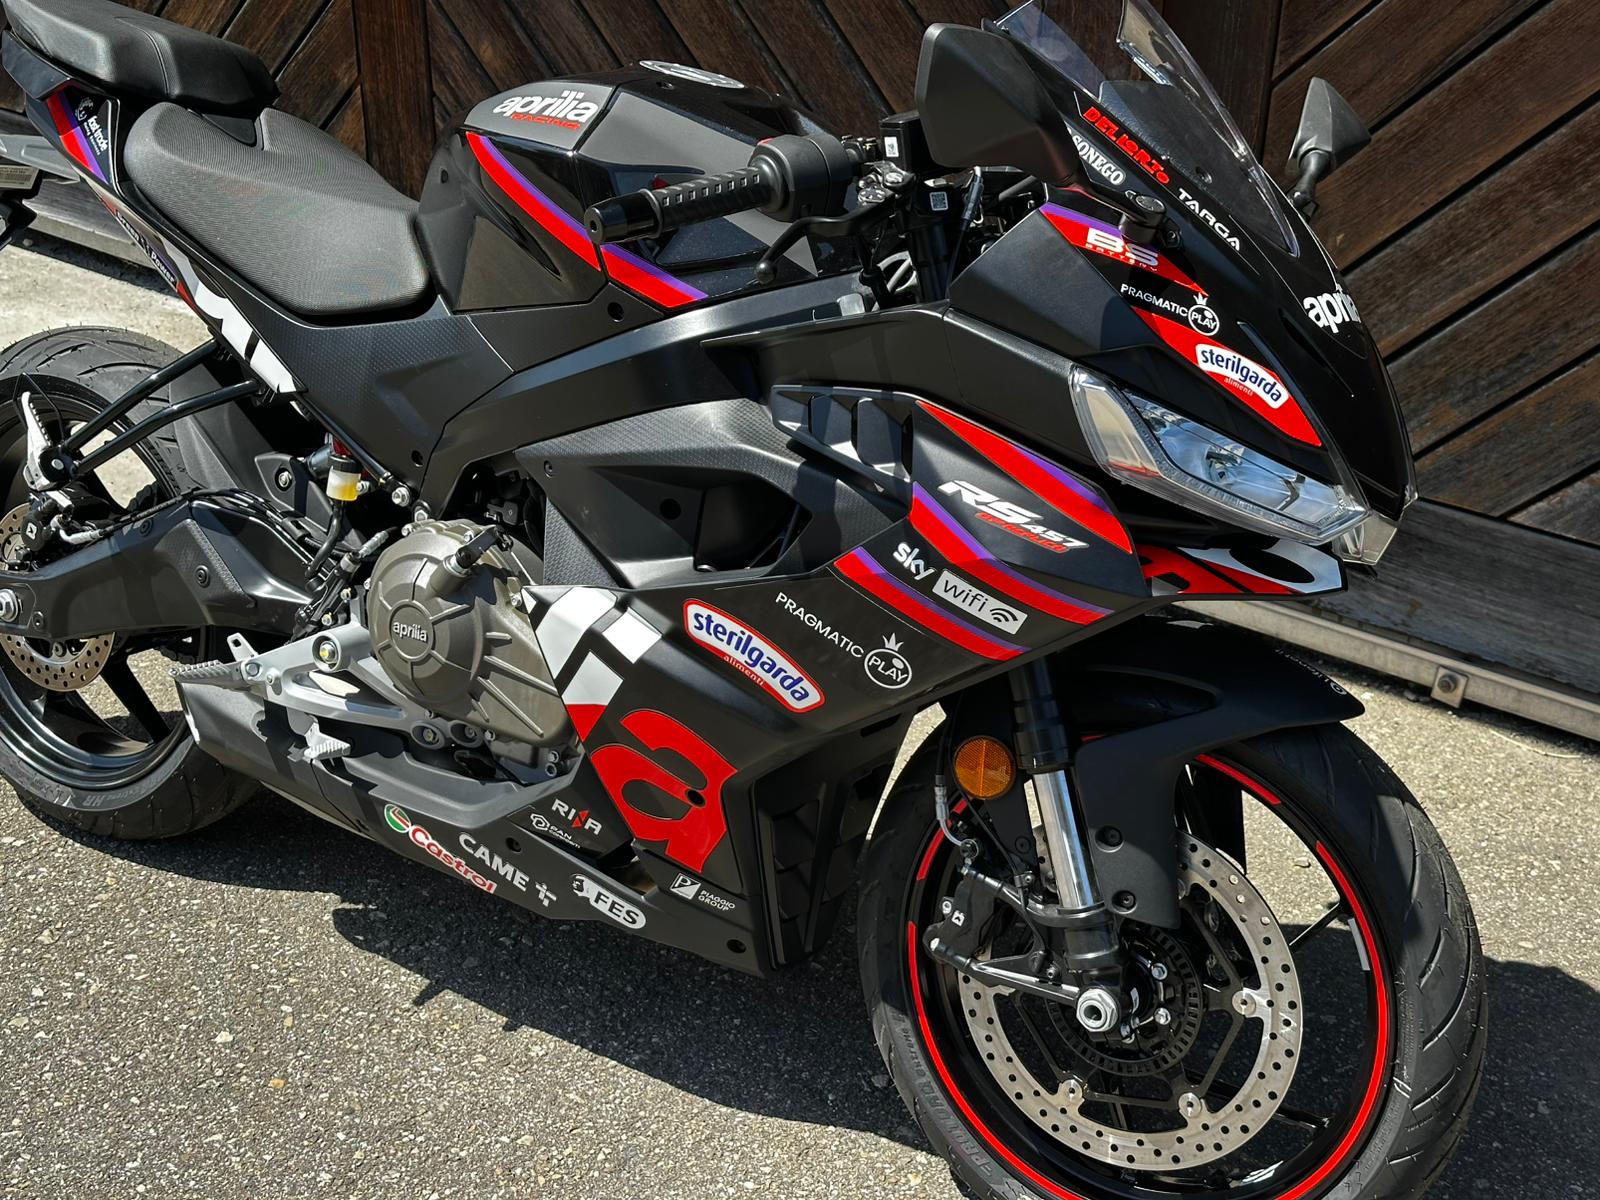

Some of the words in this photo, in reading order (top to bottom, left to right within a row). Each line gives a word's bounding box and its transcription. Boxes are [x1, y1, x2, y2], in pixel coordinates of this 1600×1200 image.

[493, 90, 599, 123] aprilia
[511, 113, 580, 130] RACING
[1178, 188, 1241, 251] TARGA
[1120, 283, 1188, 318] PRAGMATIC
[1191, 311, 1218, 330] PLAY
[1201, 348, 1282, 403] sterilgarda
[1223, 376, 1254, 397] alimenti
[937, 480, 1044, 525] RS
[1020, 523, 1089, 551] 457
[893, 542, 935, 580] sky
[943, 577, 989, 612] wifi
[393, 621, 428, 643] aprilia
[775, 592, 864, 659] PRAGMATIC
[693, 610, 810, 703] sterilgarda
[723, 653, 765, 686] alimenti
[868, 655, 908, 683] PLAY
[408, 825, 497, 894] Castrol
[458, 832, 531, 893] CAME
[593, 890, 640, 927] FES
[698, 895, 731, 912] GROUP
[700, 889, 736, 910] PIAGGIO
